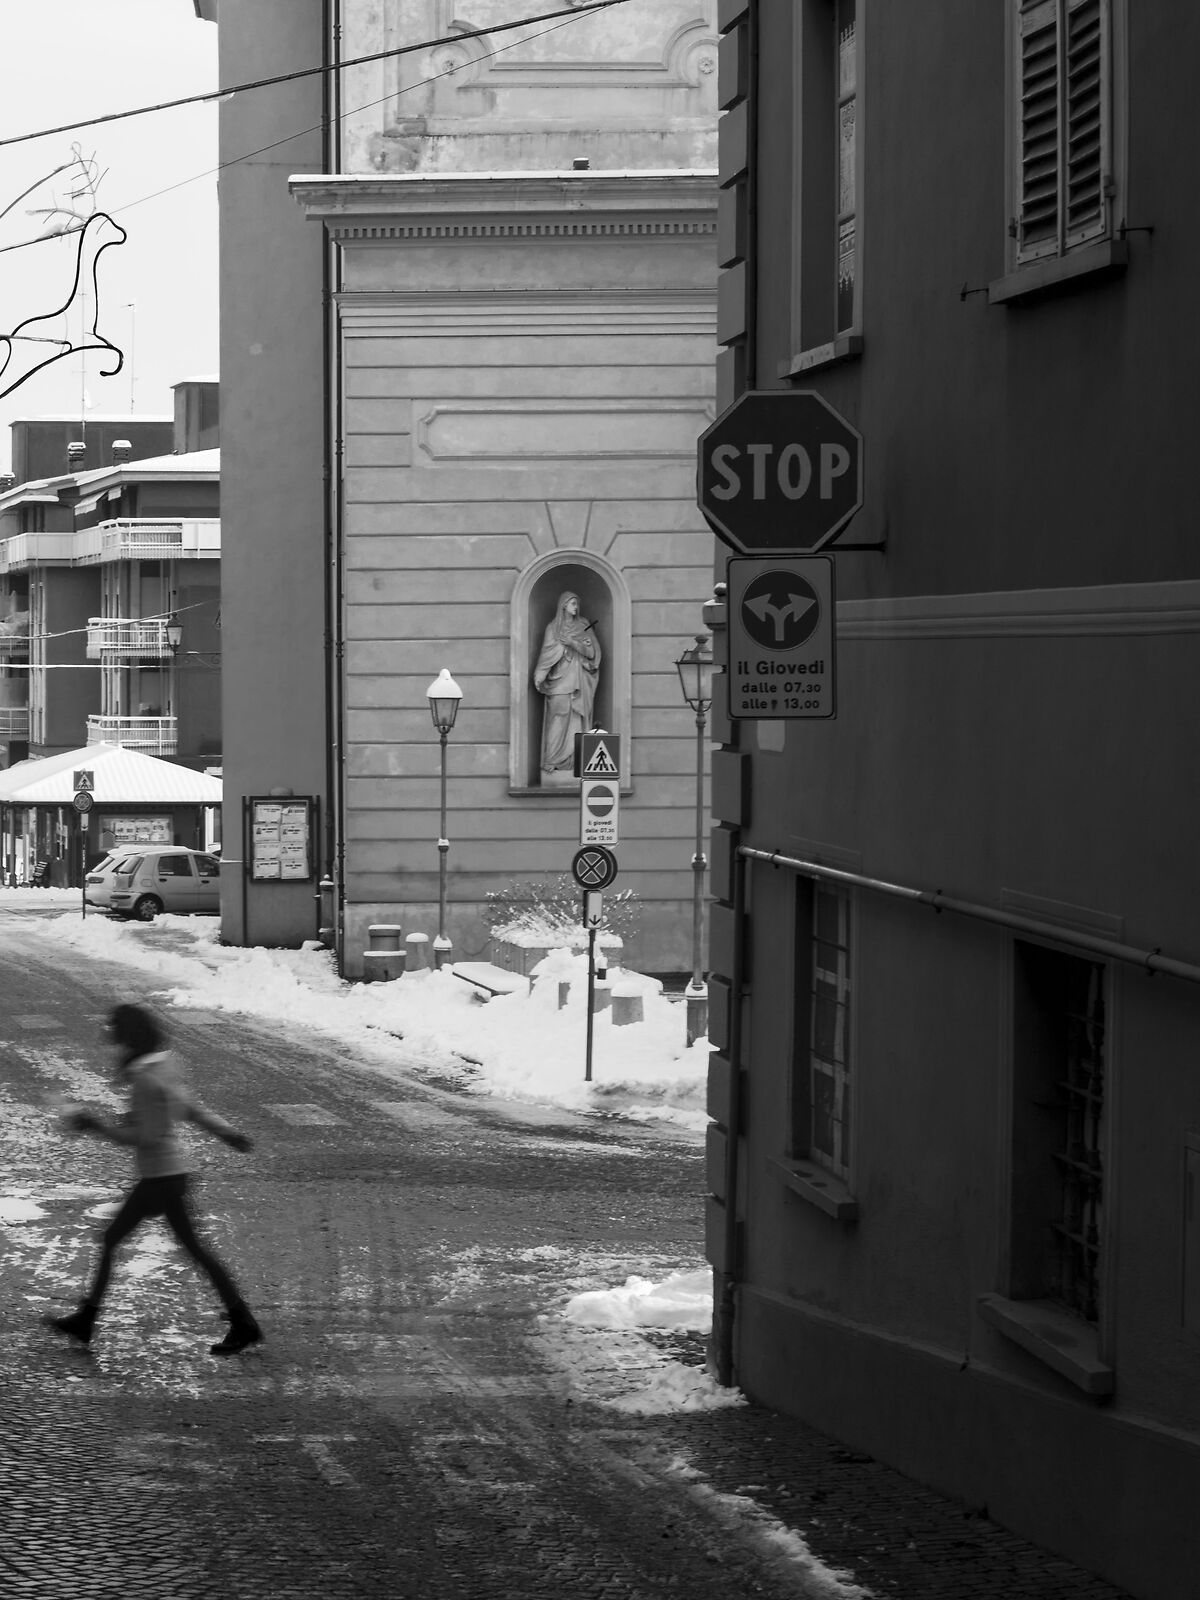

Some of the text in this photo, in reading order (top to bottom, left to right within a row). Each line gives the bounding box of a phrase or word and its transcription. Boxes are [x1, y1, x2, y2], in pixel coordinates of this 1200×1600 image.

[710, 443, 851, 500] STOP
[738, 661, 750, 675] il
[742, 682, 821, 693] dalle 07.30
[742, 698, 820, 709] alle 13.00
